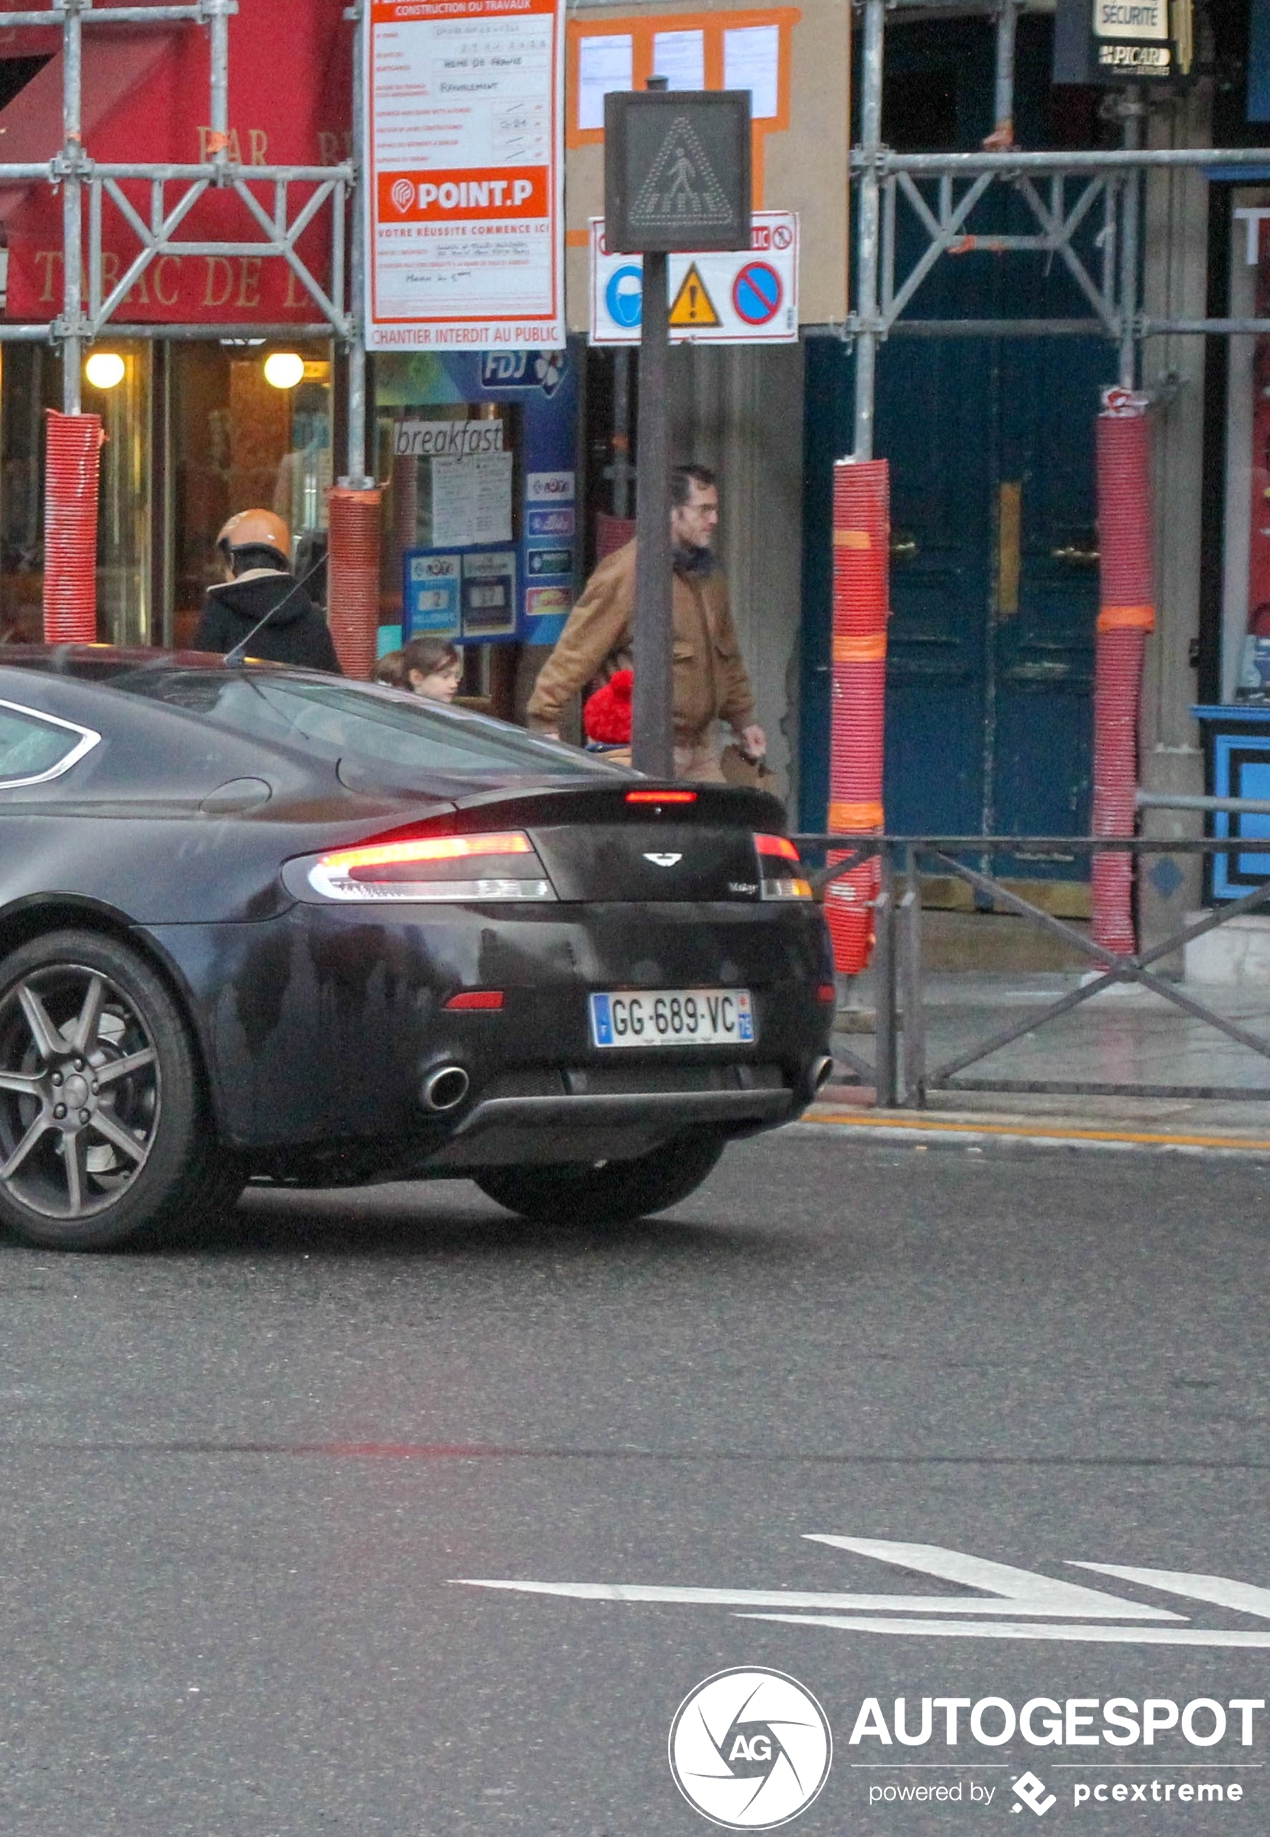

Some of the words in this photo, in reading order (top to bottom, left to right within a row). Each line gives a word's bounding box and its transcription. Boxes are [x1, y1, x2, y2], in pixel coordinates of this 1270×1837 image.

[395, 3, 466, 16] CONSTRUCTION
[469, 2, 483, 12] OU
[418, 179, 533, 209] POINT.P
[378, 227, 413, 238] VOTRE
[417, 225, 467, 237] RÉUSSITE
[471, 225, 531, 236] COMMENCE
[535, 224, 549, 233] ICI
[204, 256, 263, 307] DE
[372, 328, 431, 345] CHANTIER
[435, 327, 490, 343] INTERDIT
[493, 327, 511, 342] AU
[515, 326, 558, 342] PUBLIC
[484, 351, 528, 379] FDJ
[396, 421, 503, 461] breakfast
